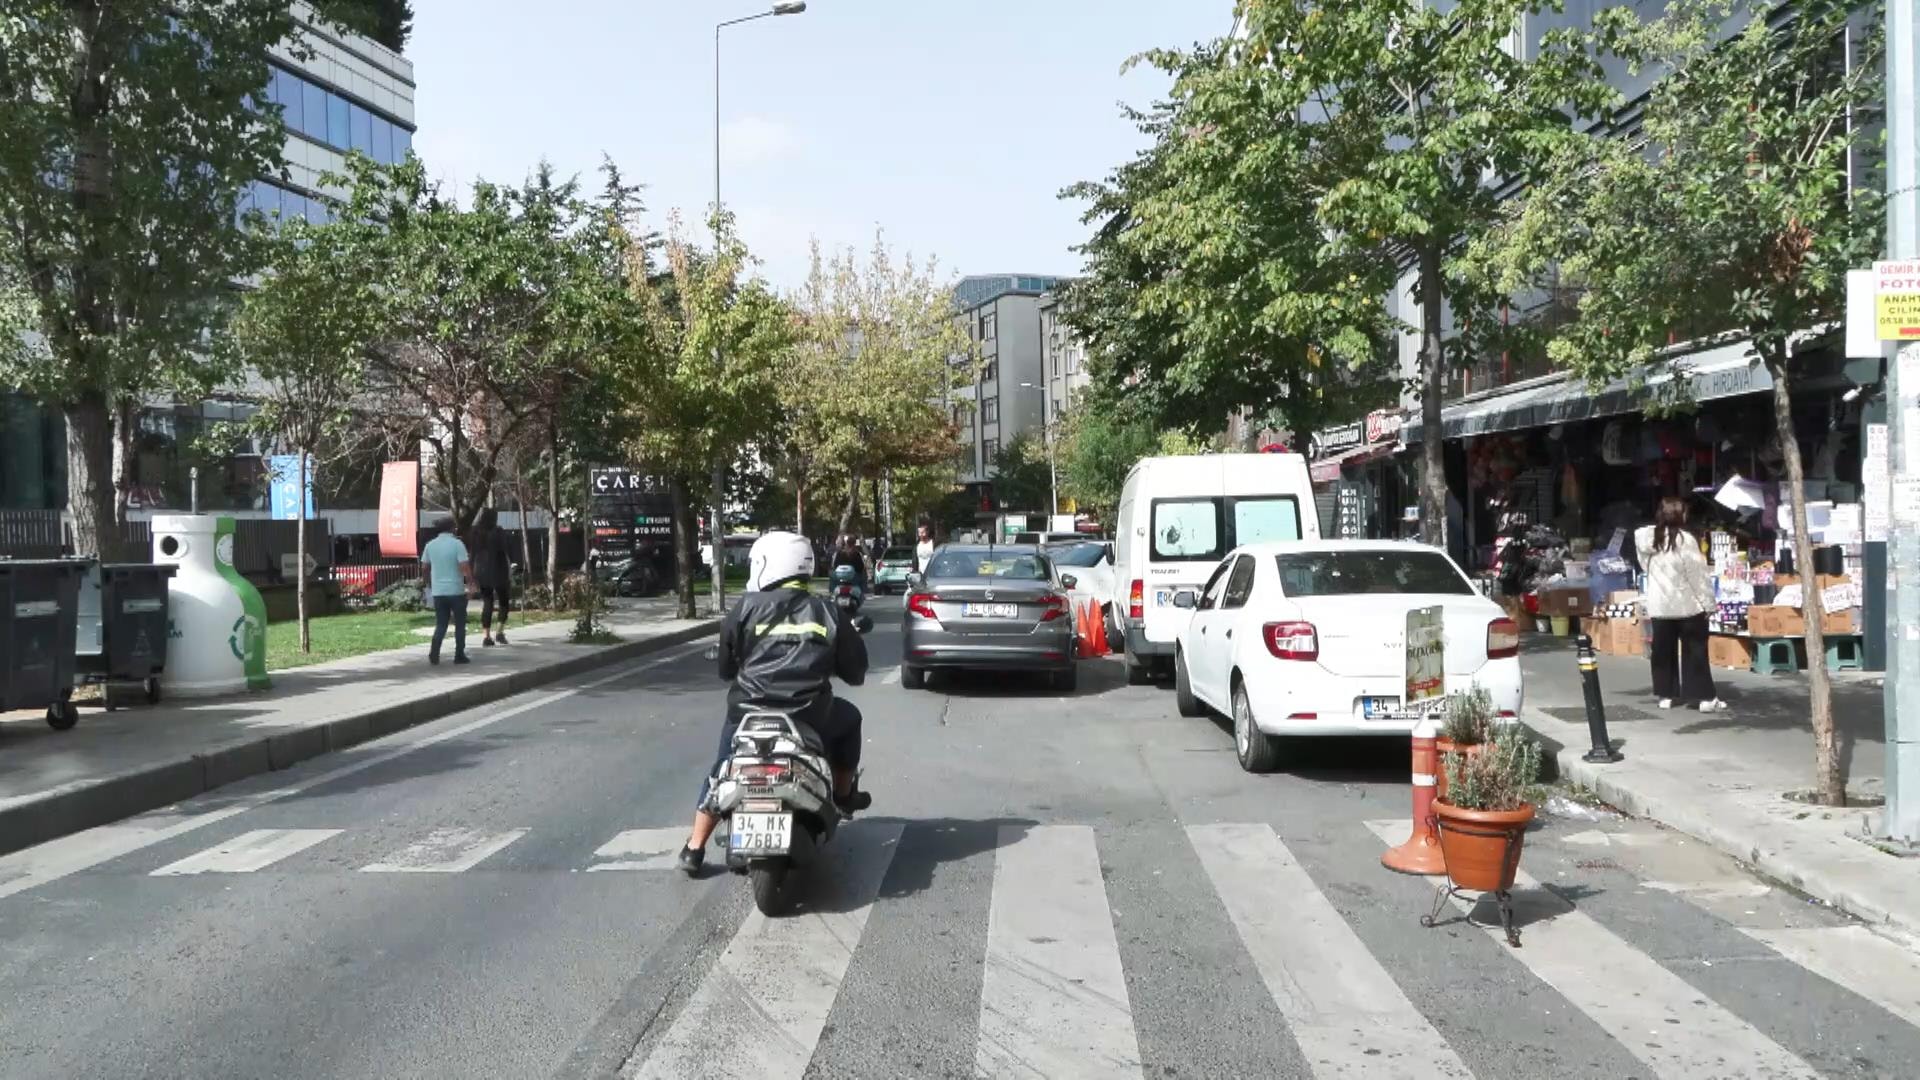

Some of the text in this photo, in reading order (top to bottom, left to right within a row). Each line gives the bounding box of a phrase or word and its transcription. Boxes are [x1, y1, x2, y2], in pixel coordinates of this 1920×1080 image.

[651, 527, 670, 535] PARK
[1374, 699, 1388, 712] 34
[738, 816, 786, 831] 34 MK
[745, 834, 783, 849] 7683
